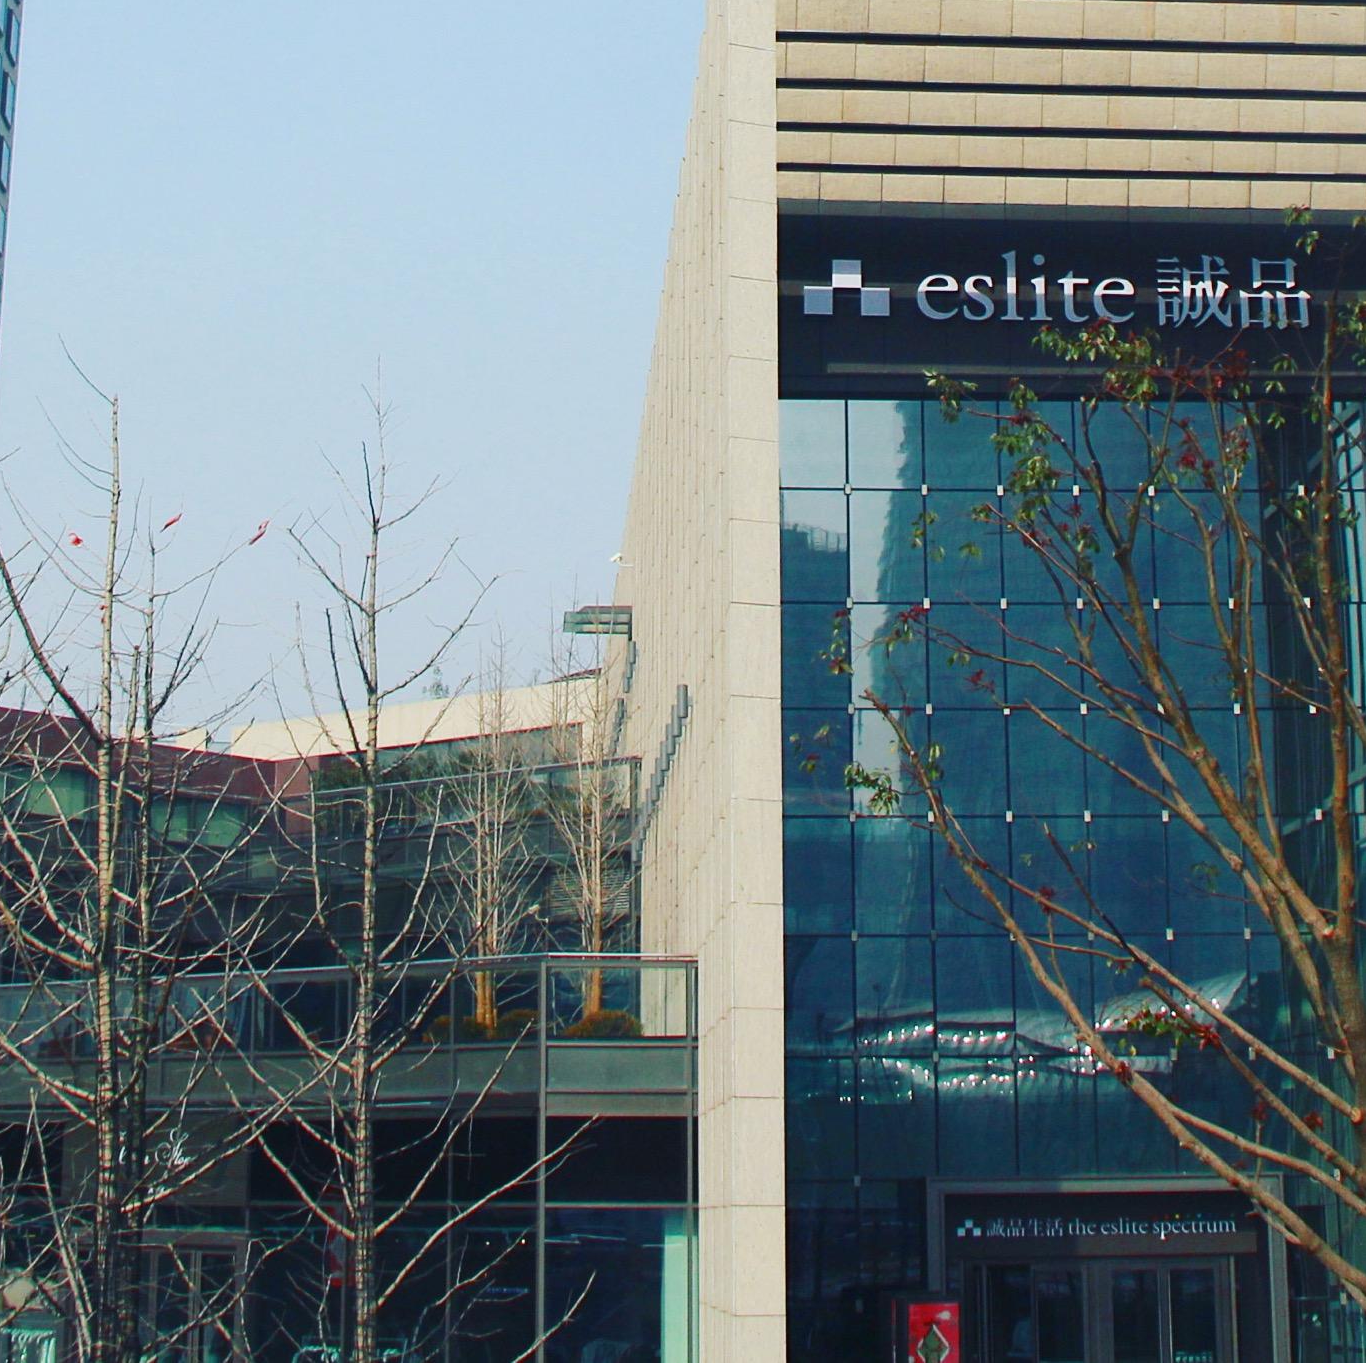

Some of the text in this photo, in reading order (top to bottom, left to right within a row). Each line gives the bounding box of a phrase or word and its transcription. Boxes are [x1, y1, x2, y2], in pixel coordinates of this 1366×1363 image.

[916, 250, 1311, 329] eslite 誠品
[1068, 1218, 1096, 1235] the
[1100, 1217, 1148, 1235] eslite
[1152, 1219, 1236, 1240] spectrum
